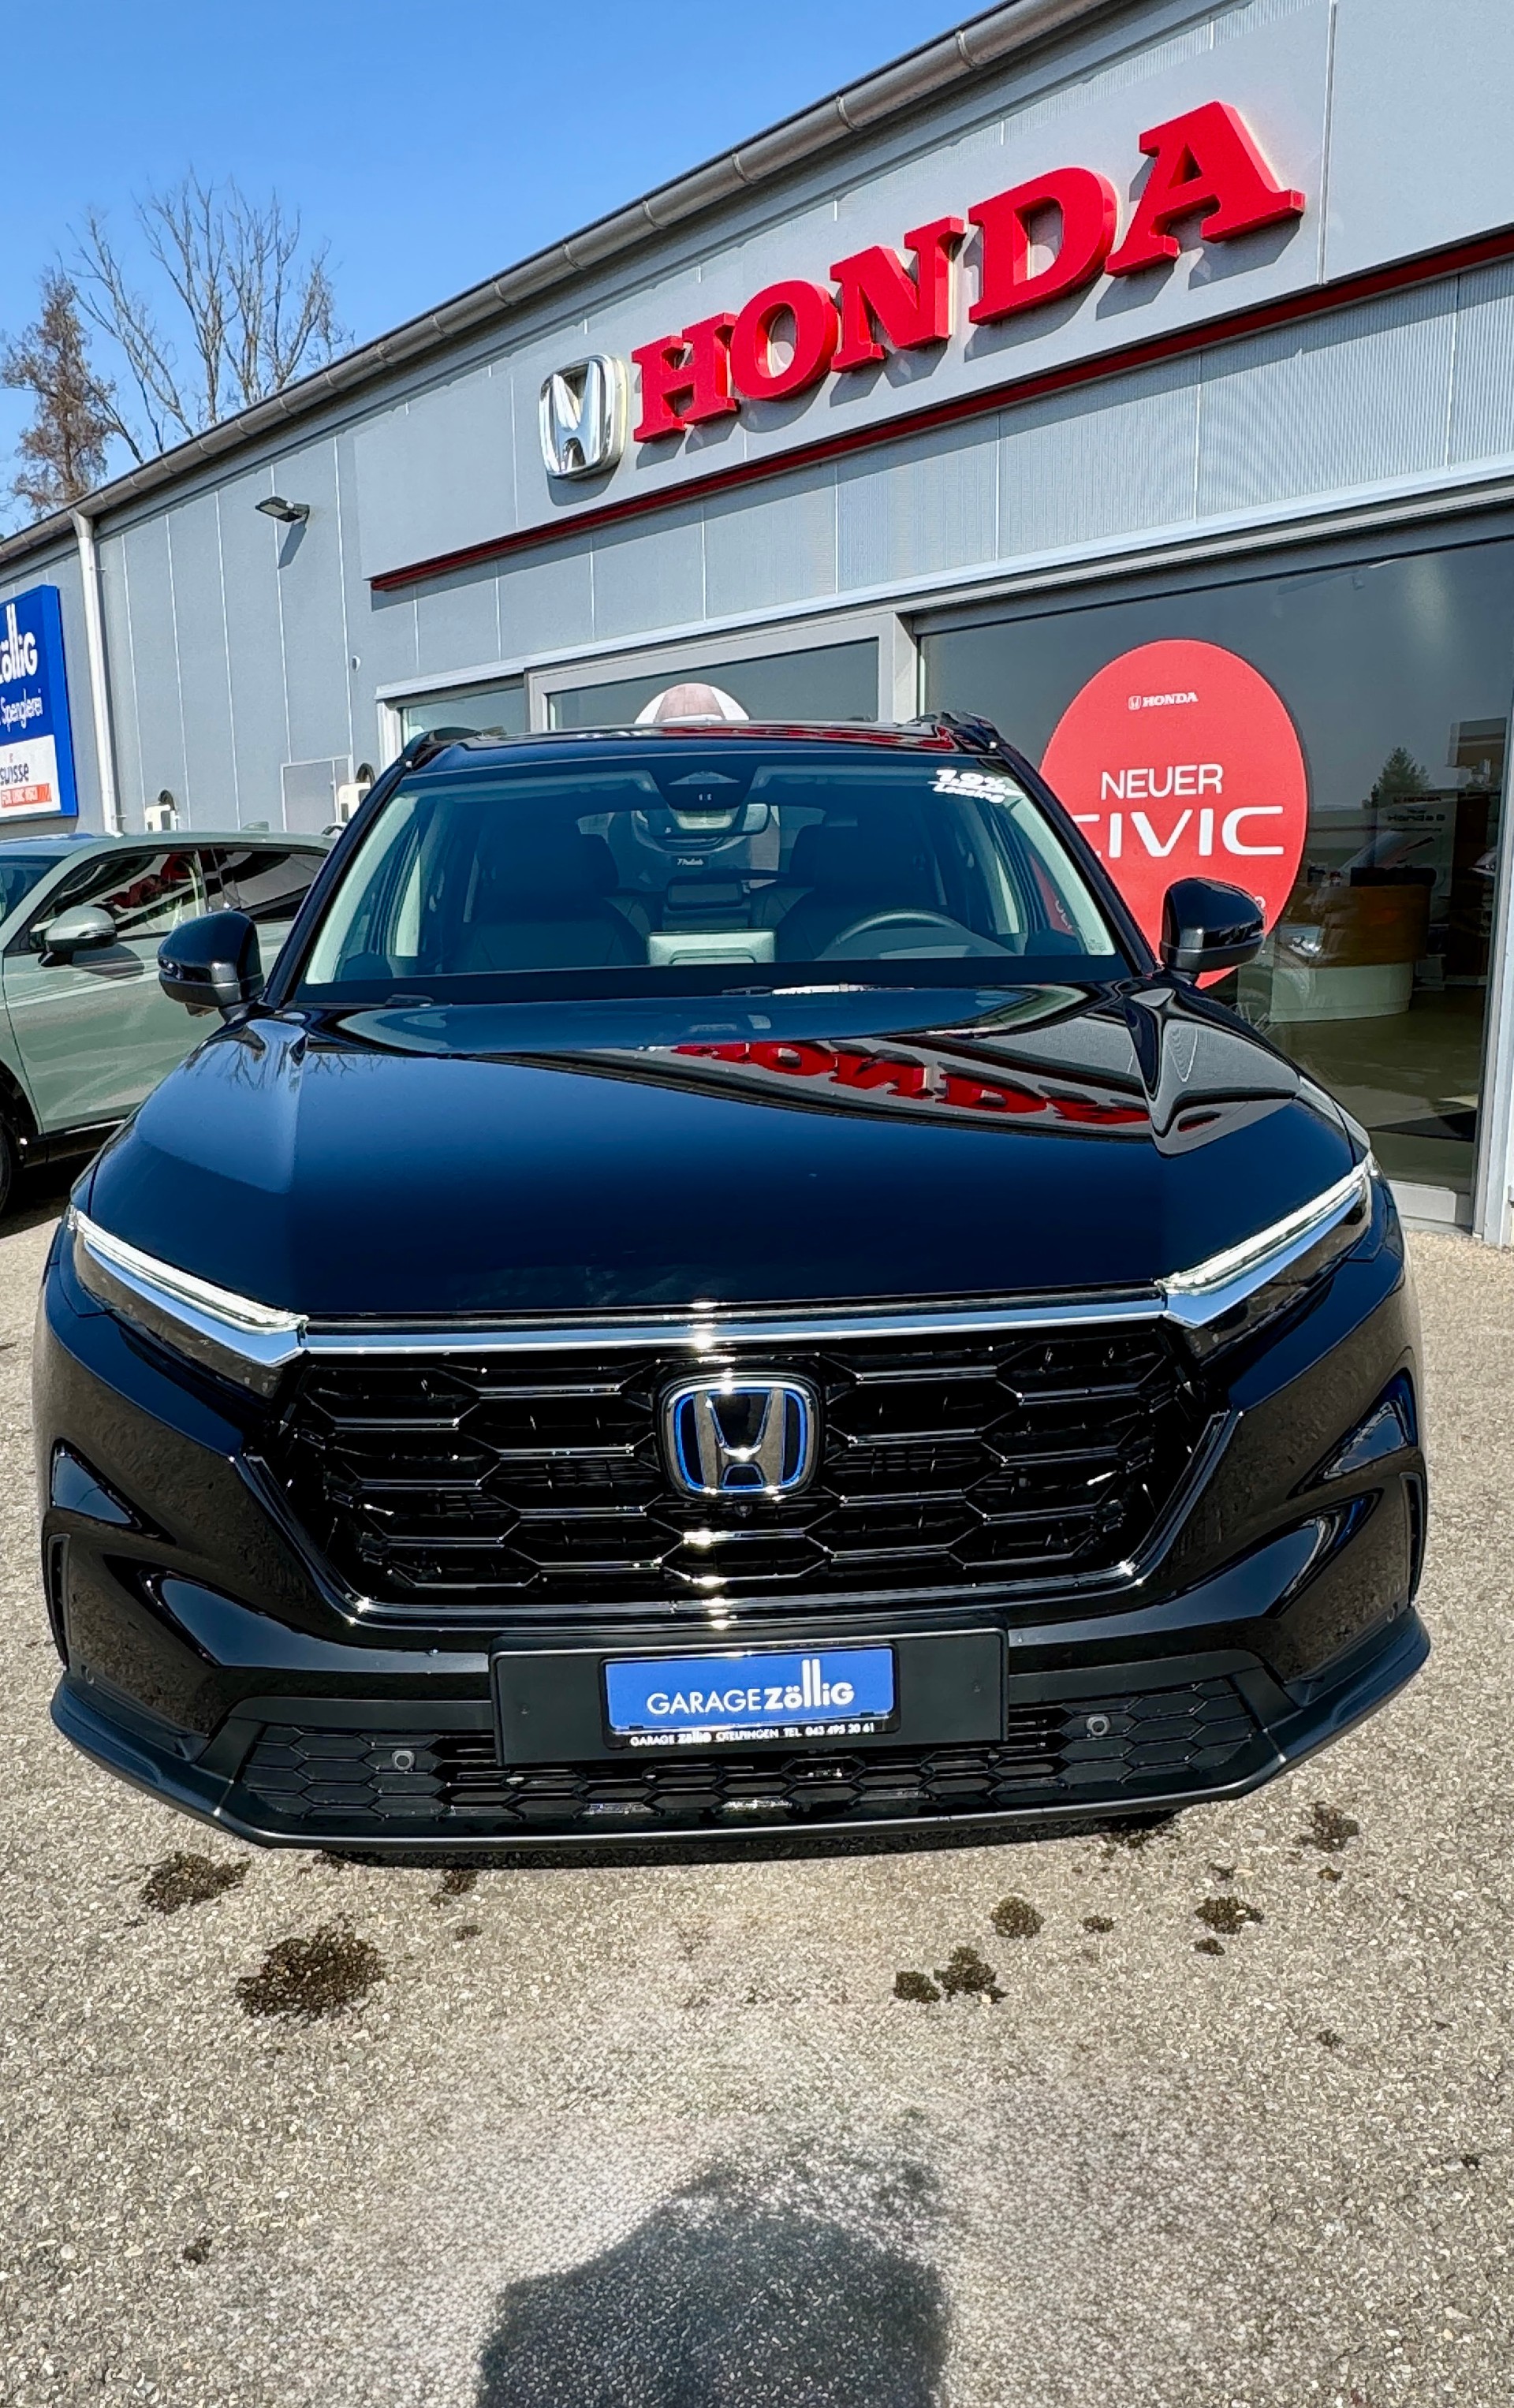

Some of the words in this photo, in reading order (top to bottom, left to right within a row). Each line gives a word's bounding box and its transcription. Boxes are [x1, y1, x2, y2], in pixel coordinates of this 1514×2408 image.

[632, 100, 1304, 443] HONDA
[0, 603, 38, 684] ölliG
[1143, 691, 1198, 706] HONDA
[1101, 763, 1223, 800] NEUER
[647, 1688, 763, 1715] GARAGE
[630, 1734, 674, 1746] GARAGE
